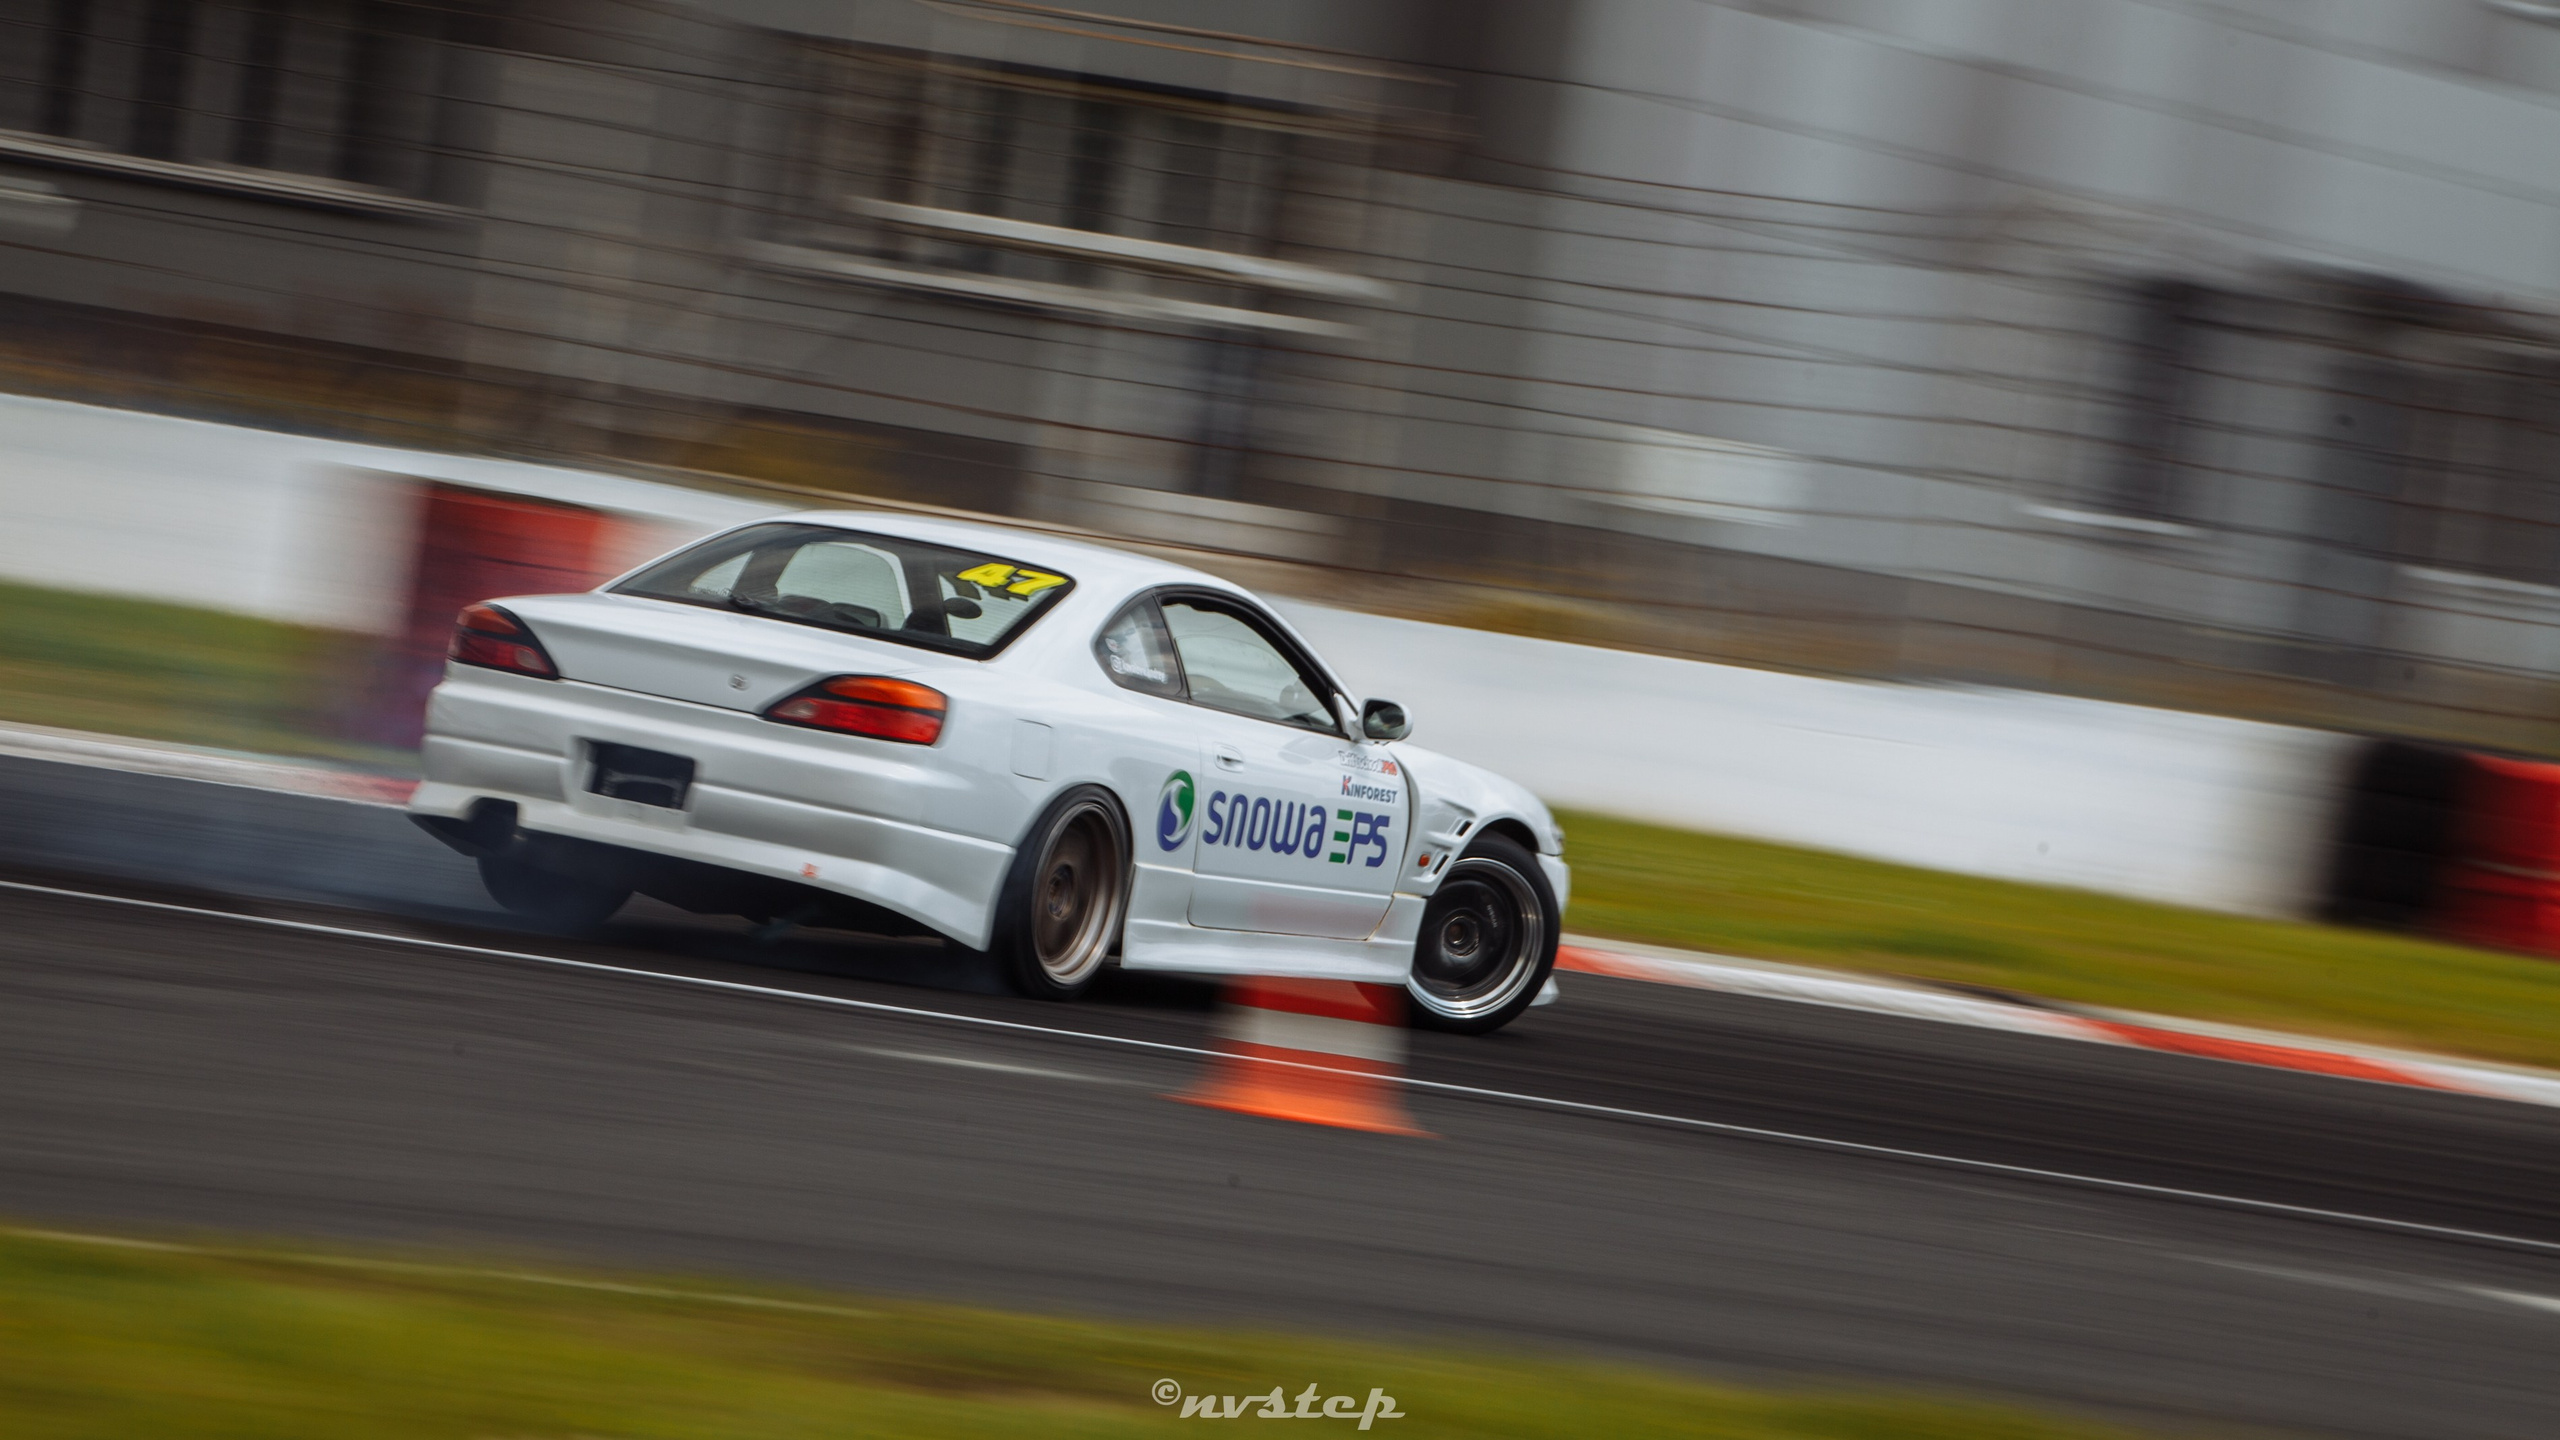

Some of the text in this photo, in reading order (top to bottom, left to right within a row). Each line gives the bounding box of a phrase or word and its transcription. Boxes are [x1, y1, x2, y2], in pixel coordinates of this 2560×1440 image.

[956, 562, 1069, 596] 47
[1341, 775, 1398, 804] KINFOREST
[1328, 809, 1390, 868] EPS
